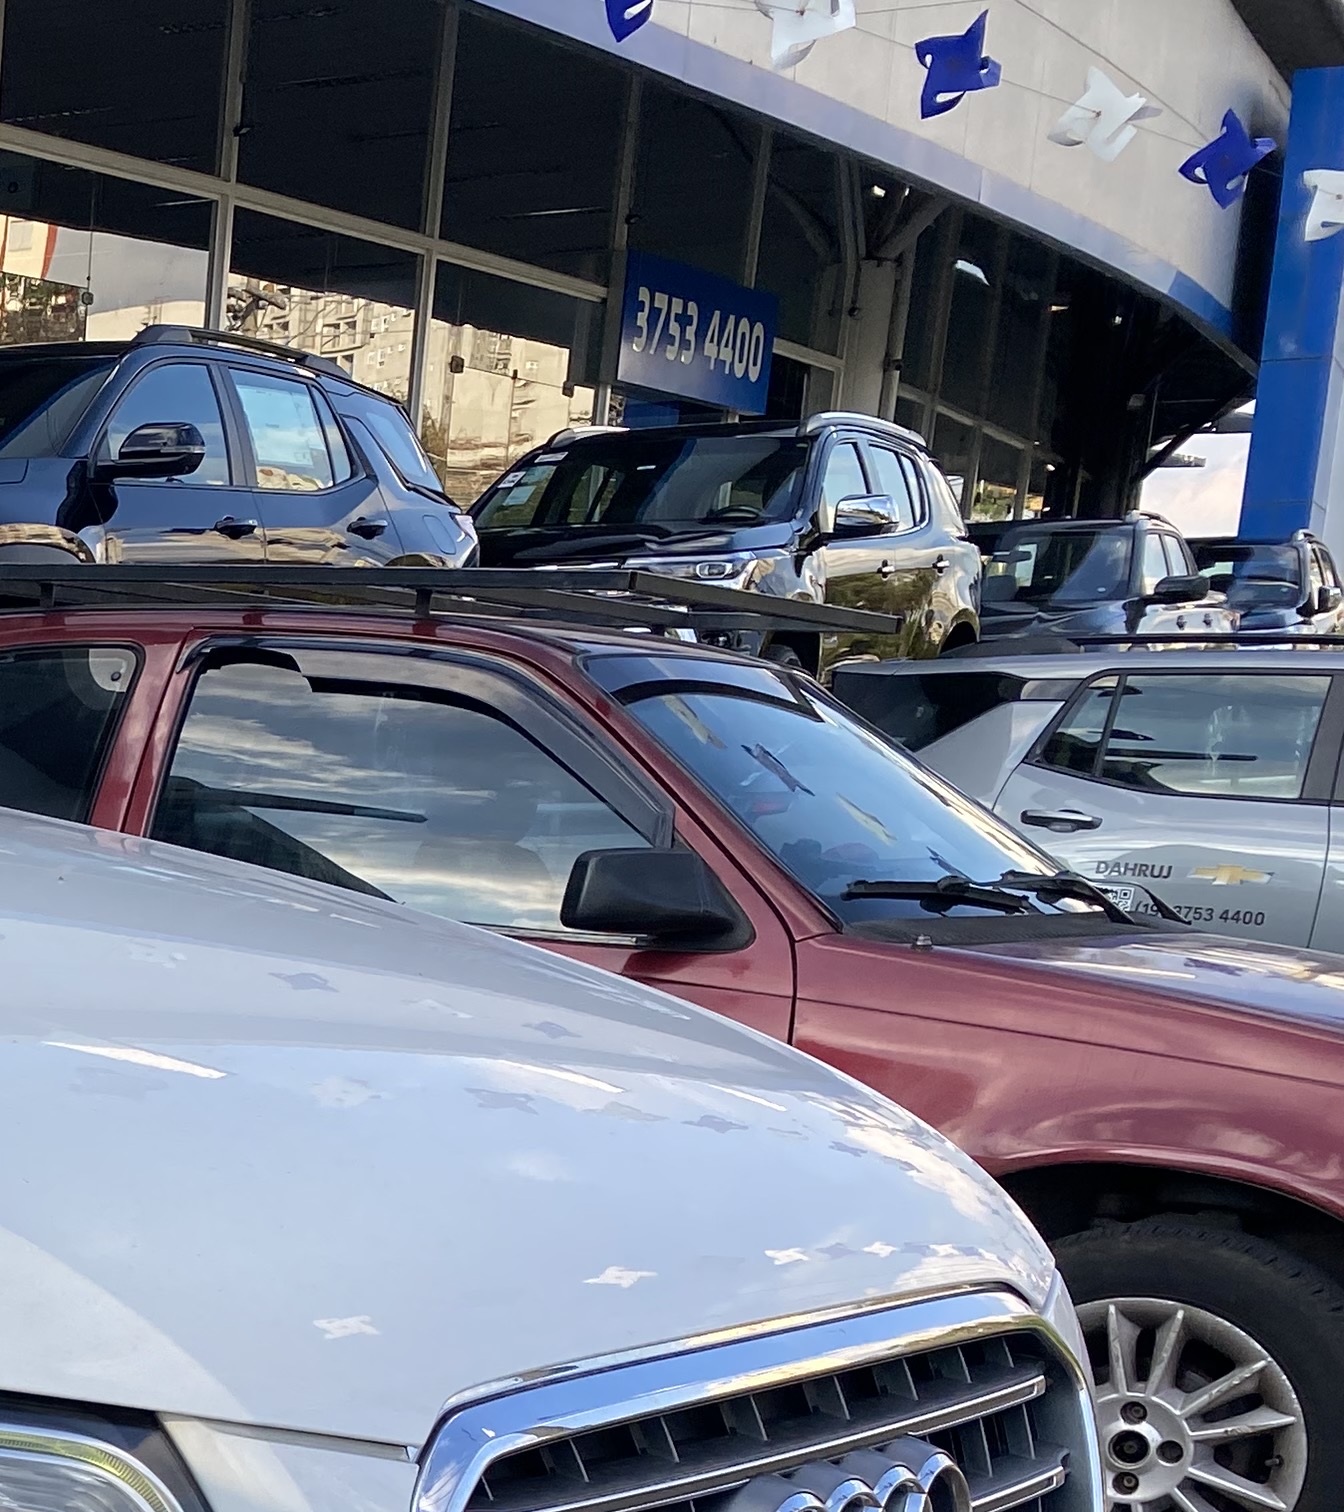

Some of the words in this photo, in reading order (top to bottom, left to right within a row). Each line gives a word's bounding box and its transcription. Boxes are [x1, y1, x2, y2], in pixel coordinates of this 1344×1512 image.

[632, 286, 699, 365] 3753
[703, 309, 765, 384] 4400
[1095, 860, 1173, 880] DAHRUJ
[1218, 908, 1266, 927] 4400
